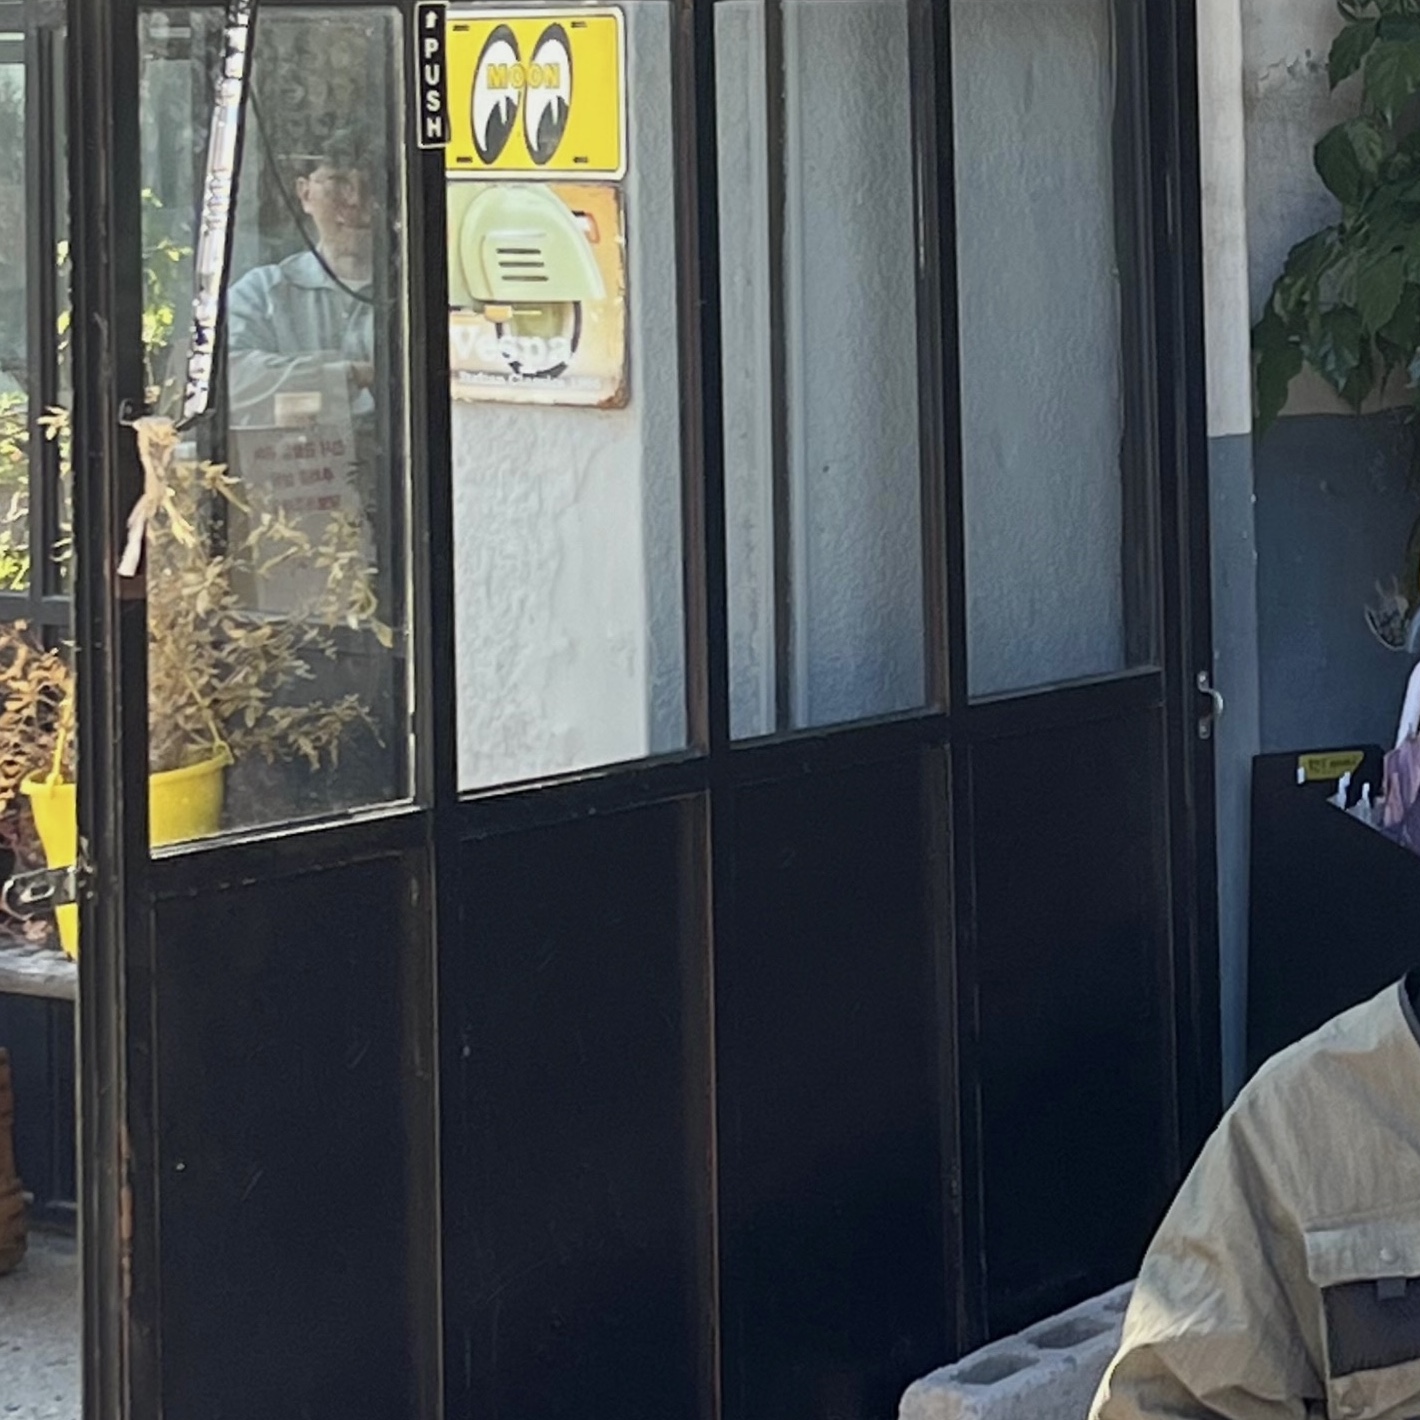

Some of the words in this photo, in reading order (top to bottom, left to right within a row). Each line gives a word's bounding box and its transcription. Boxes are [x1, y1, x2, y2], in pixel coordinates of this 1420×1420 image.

[425, 38, 442, 138] PUSH
[487, 62, 561, 90] MOON
[450, 325, 573, 373] Vespa
